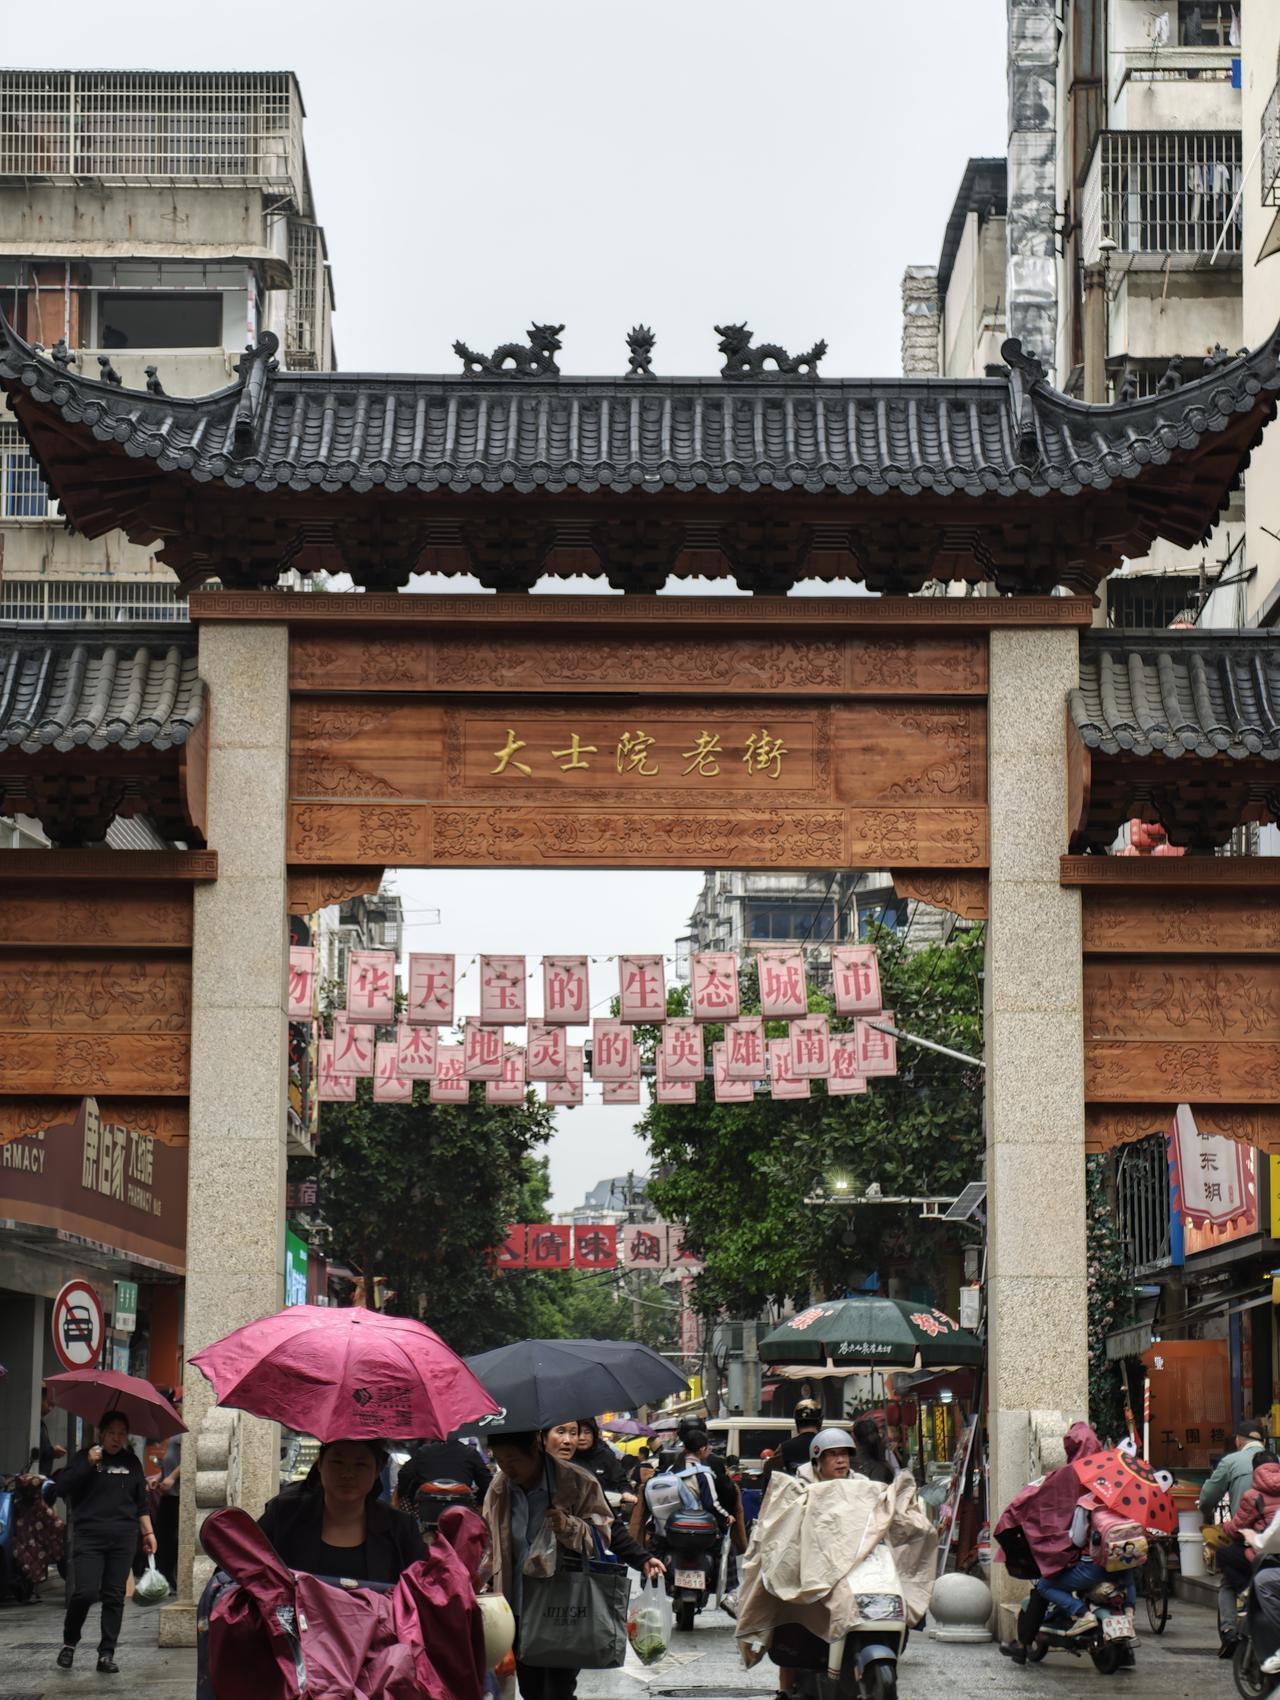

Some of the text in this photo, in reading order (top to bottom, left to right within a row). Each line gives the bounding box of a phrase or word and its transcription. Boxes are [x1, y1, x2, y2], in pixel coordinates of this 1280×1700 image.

[490, 729, 788, 779] 大士院老街
[337, 1026, 889, 1067] 人杰地灵的英雄南昌
